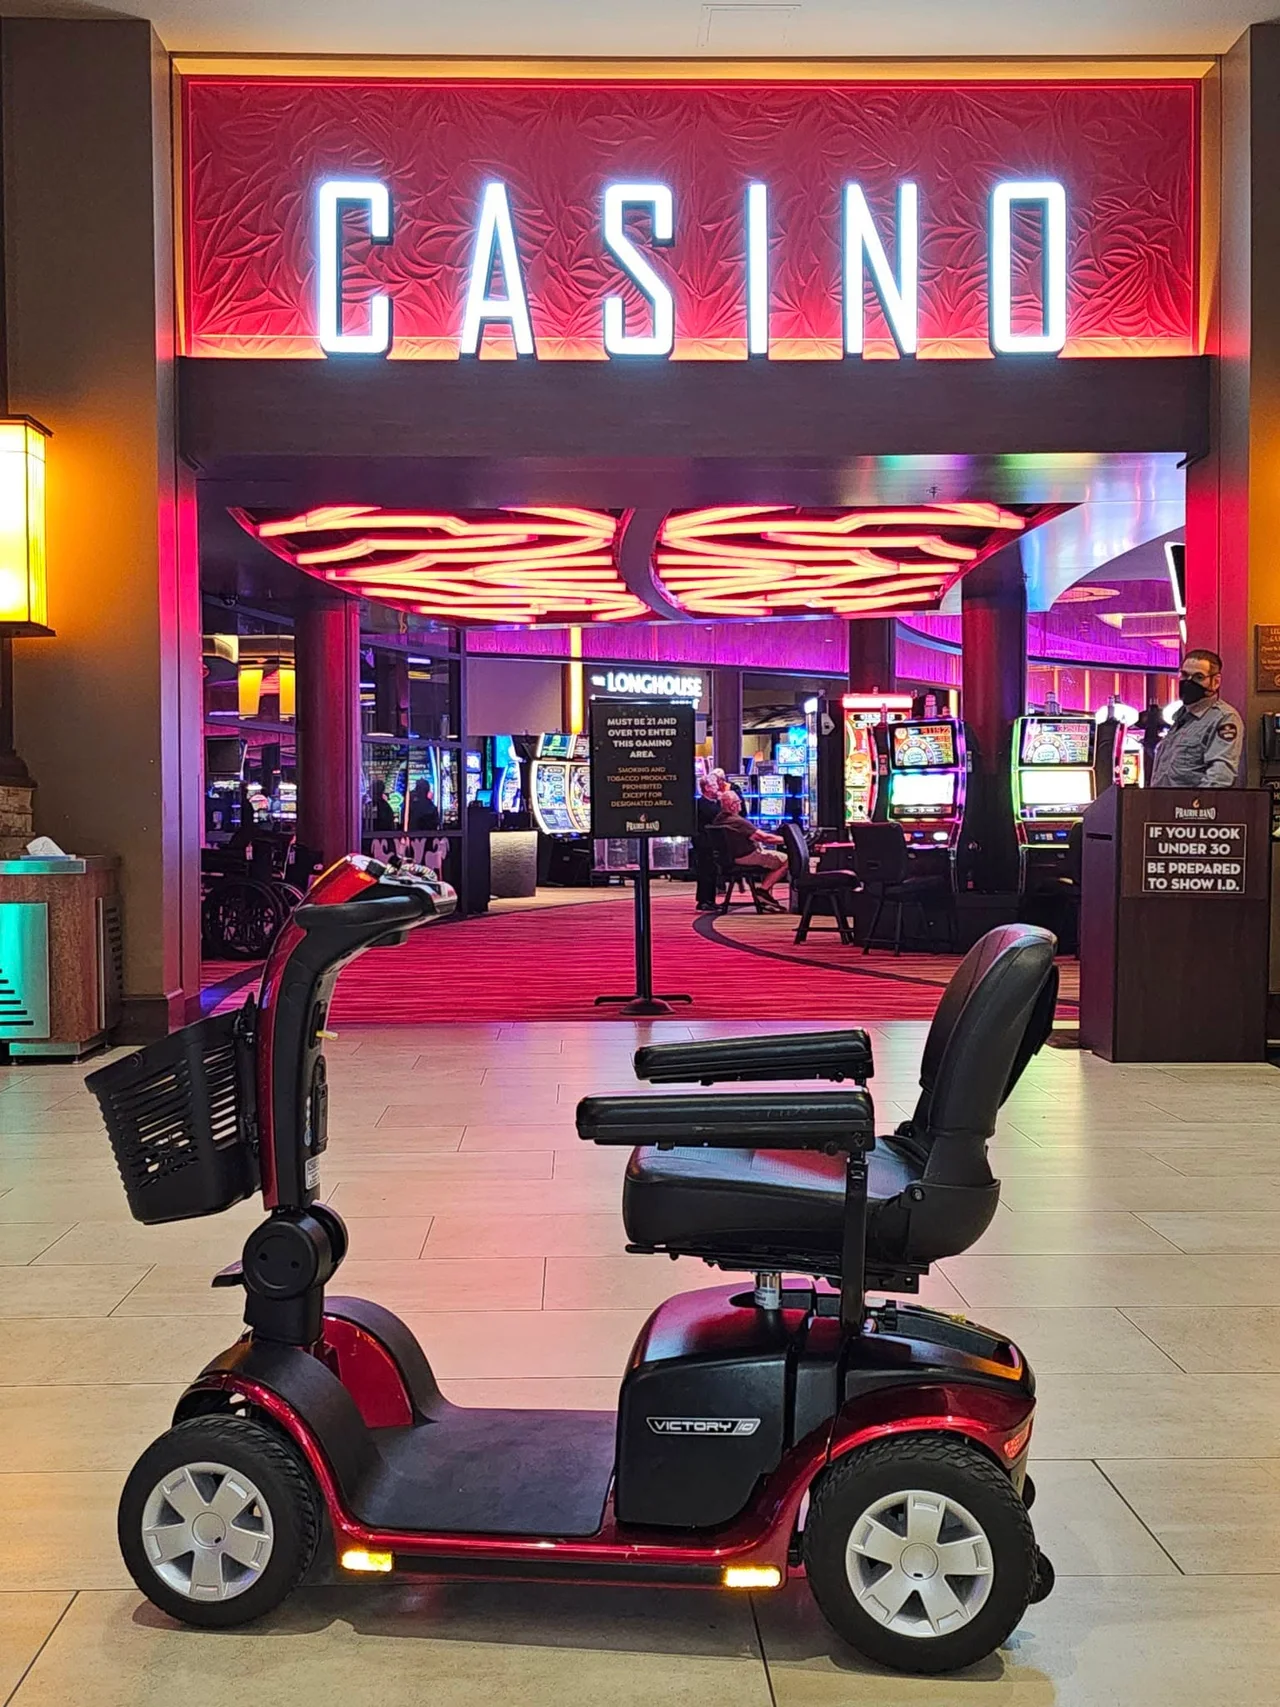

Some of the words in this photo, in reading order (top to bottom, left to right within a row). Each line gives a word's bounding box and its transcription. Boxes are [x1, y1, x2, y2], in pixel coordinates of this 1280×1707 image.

[318, 180, 1067, 357] CASINO
[606, 672, 702, 697] LONGHOUSE
[607, 718, 632, 726] MUST
[634, 718, 645, 726] BE
[607, 729, 632, 737] OVER
[648, 728, 677, 736] ENTER
[613, 740, 634, 748] THIS
[635, 739, 672, 747] GAMING
[1199, 807, 1216, 820] BAND
[1150, 827, 1162, 838] IF
[1166, 827, 1196, 839] YOU
[1200, 828, 1240, 840] LOOK
[1158, 843, 1207, 855] UNDER
[1210, 843, 1231, 855] 30
[1147, 862, 1165, 874] BE
[1169, 863, 1241, 875] PREPARED
[1148, 878, 1167, 890] TO
[1171, 878, 1214, 891] SHOW
[1217, 879, 1240, 891] I.D.
[654, 1421, 732, 1432] VICTORY
